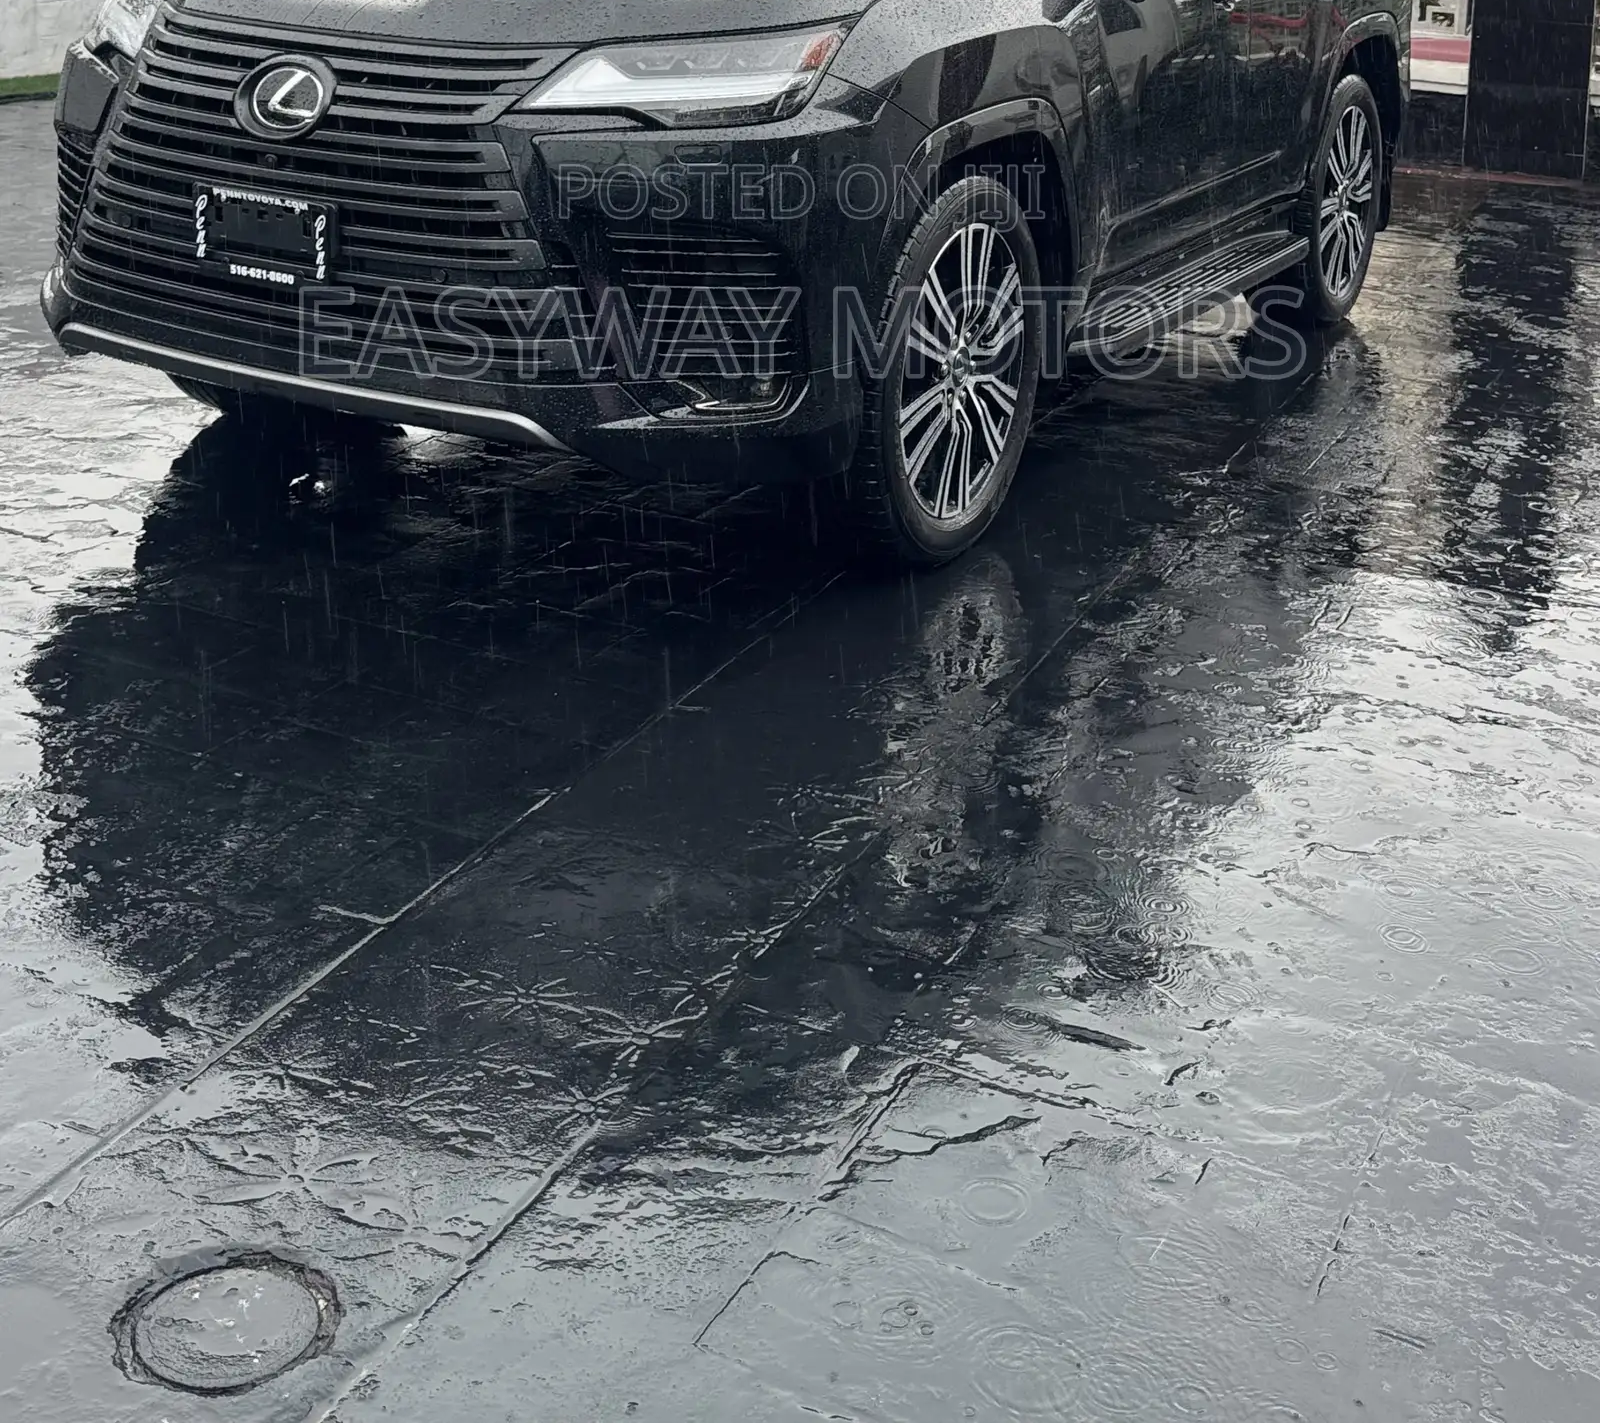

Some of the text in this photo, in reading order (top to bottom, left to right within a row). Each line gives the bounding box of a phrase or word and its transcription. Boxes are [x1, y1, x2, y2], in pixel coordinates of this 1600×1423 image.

[195, 194, 208, 258] Penn
[212, 187, 309, 211] PENNTOYOTA.COM
[314, 214, 326, 280] Penn
